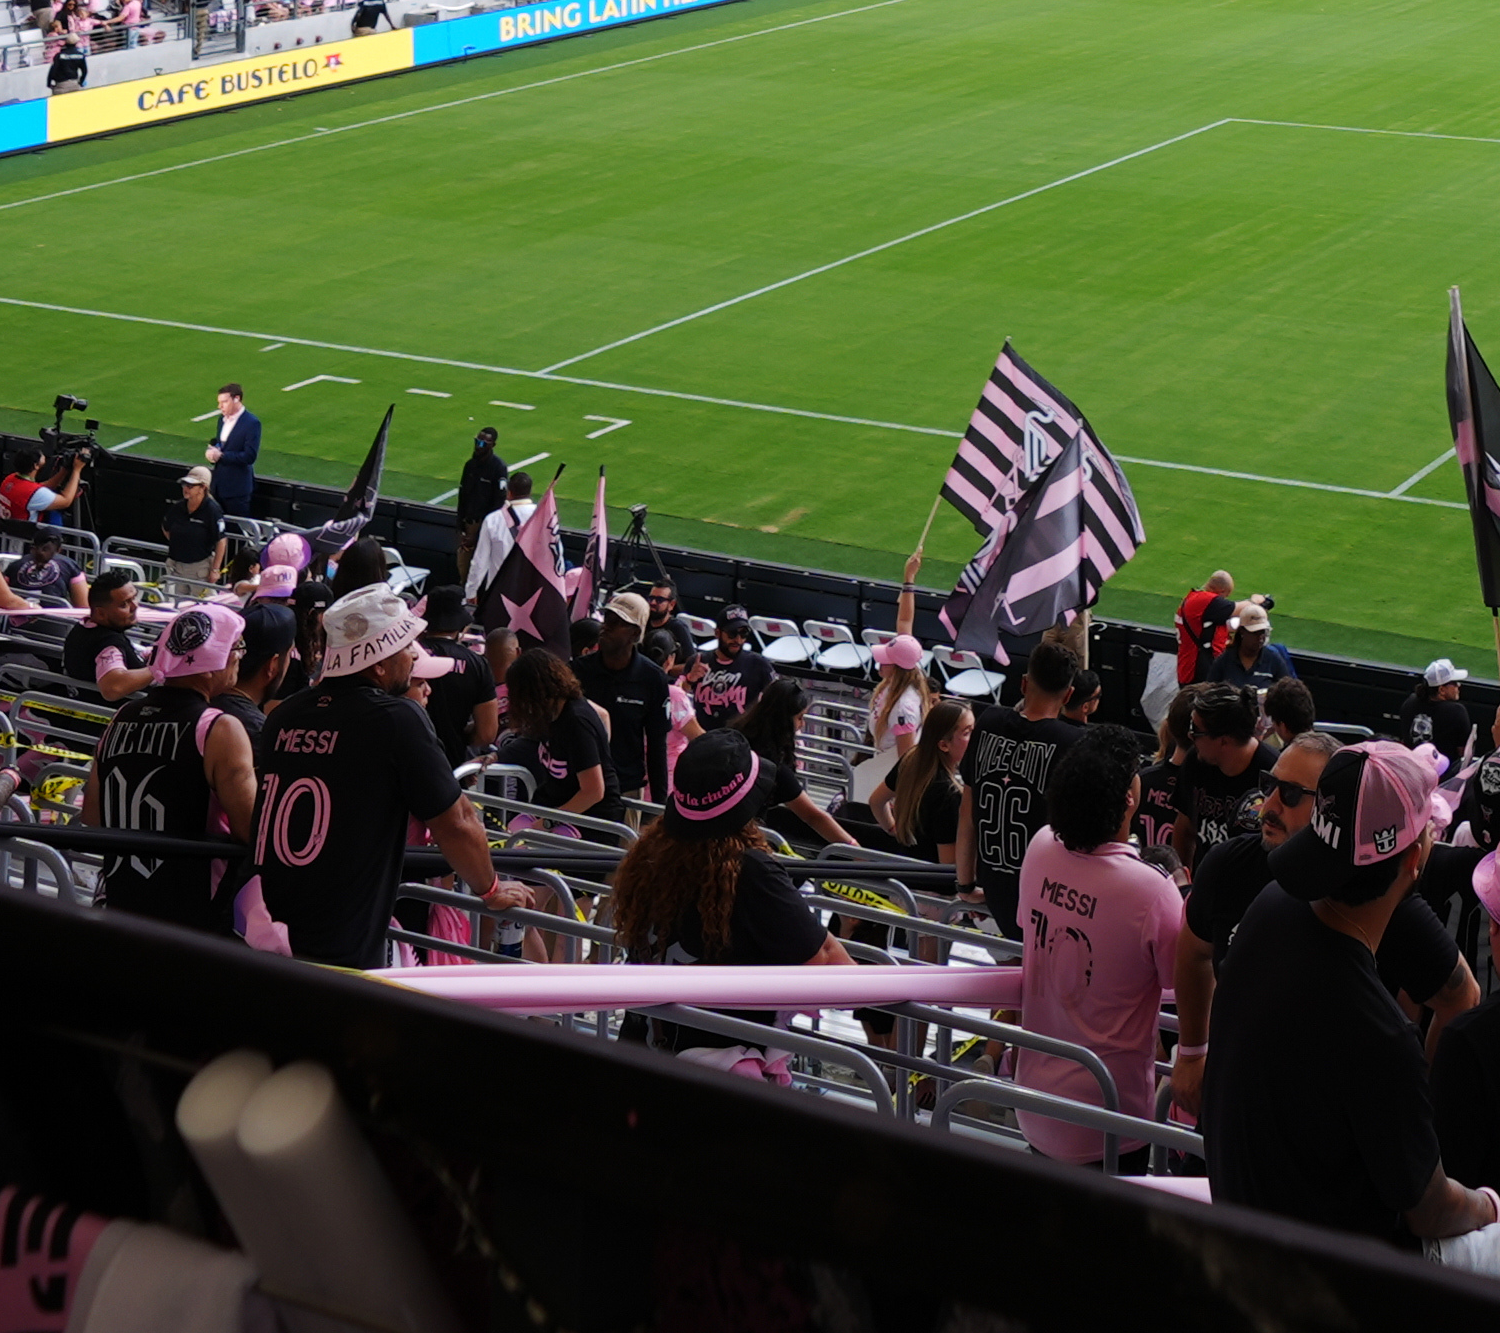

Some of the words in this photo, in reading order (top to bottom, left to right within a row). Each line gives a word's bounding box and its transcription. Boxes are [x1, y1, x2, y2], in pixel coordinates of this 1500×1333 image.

[498, 1, 584, 44] BRING
[219, 57, 319, 97] BUSTELO
[326, 653, 341, 671] LA
[137, 721, 192, 761] CITY
[274, 727, 340, 755] MESSI
[975, 731, 1015, 785] VICE
[1012, 740, 1058, 796] CITY
[1147, 788, 1173, 807] MES
[255, 773, 332, 868] 10
[1311, 806, 1340, 850] AMI
[1040, 878, 1098, 920] MESSI
[1030, 908, 1094, 1010] 10
